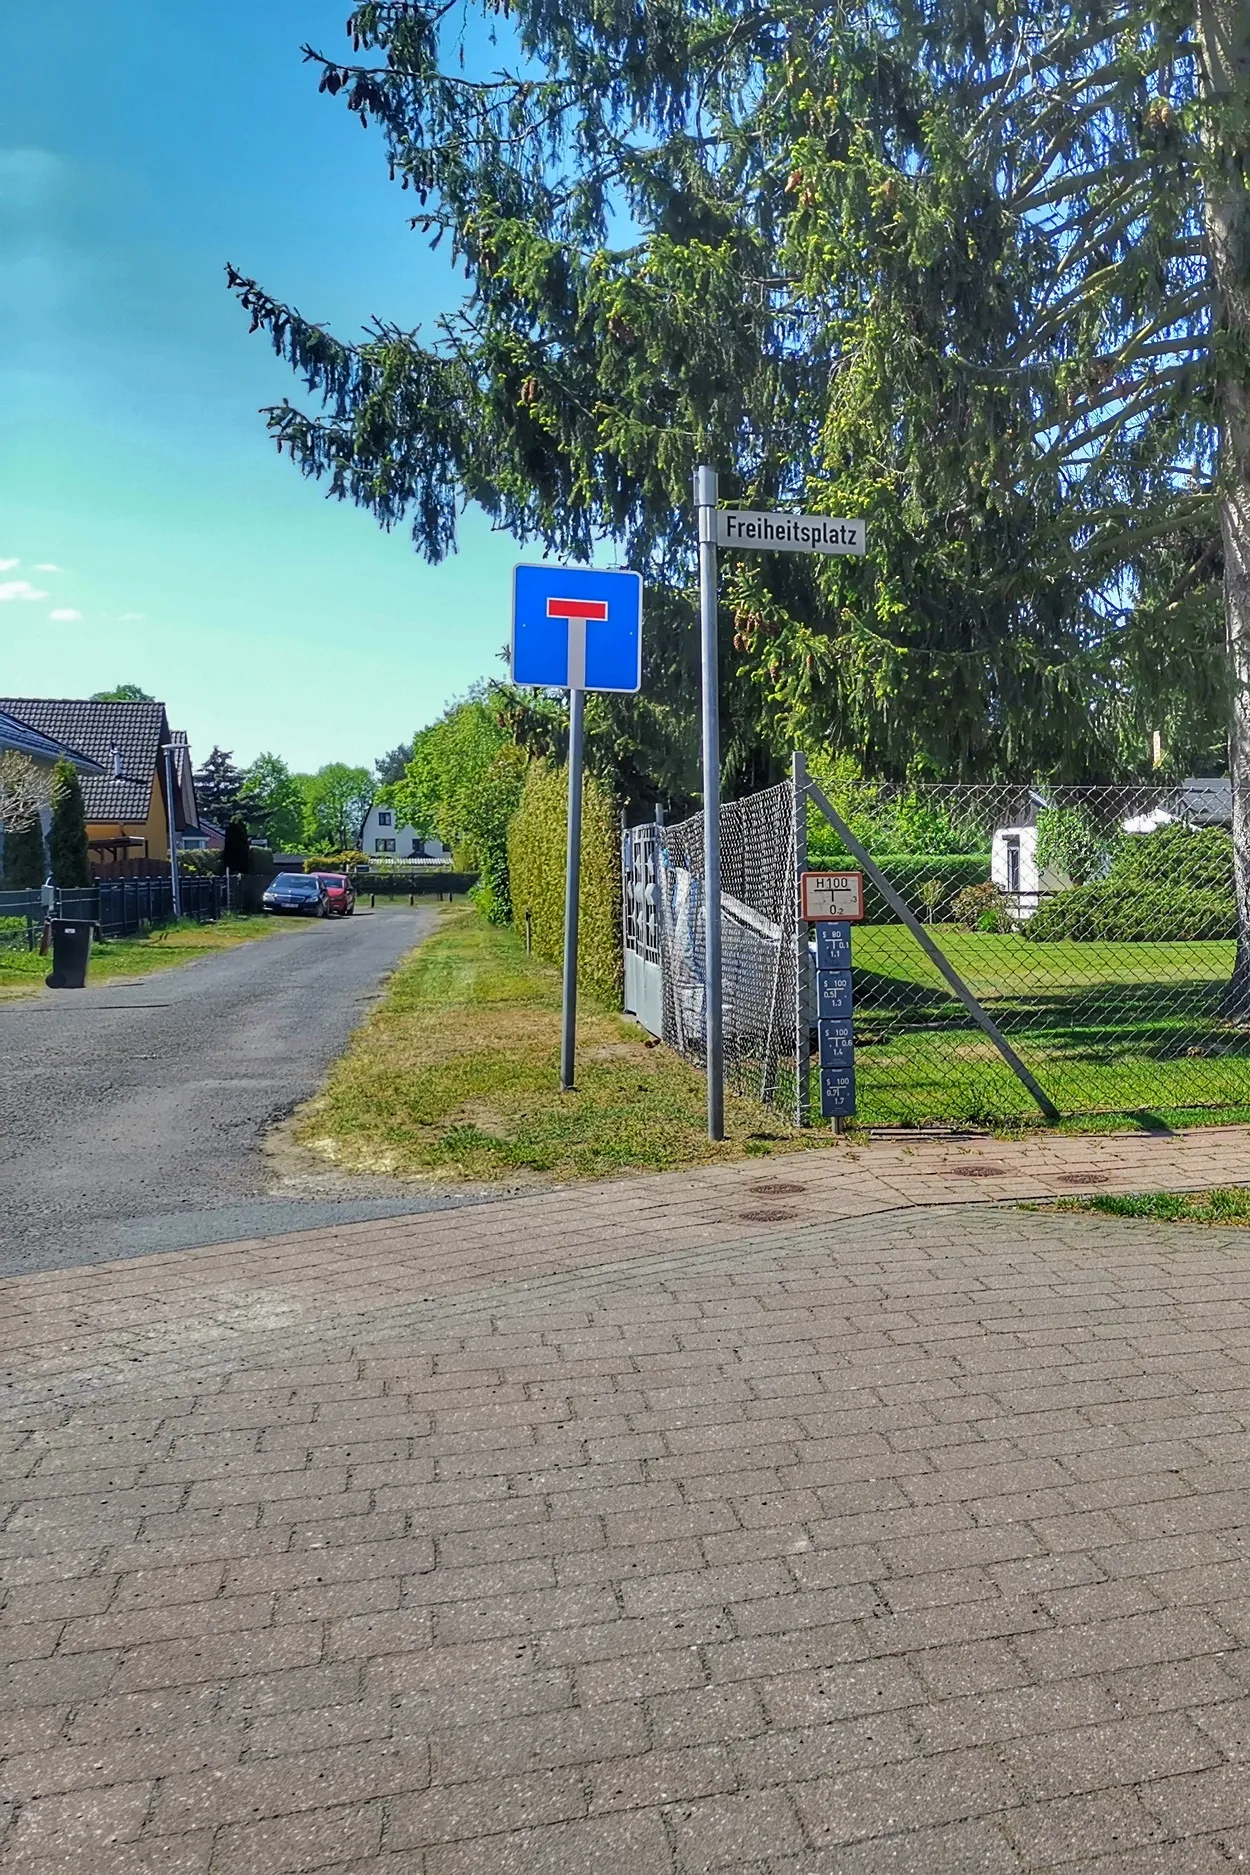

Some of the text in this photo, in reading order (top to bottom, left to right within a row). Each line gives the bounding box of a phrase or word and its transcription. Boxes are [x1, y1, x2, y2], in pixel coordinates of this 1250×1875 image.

[726, 516, 857, 548] Freiheitsplatz
[822, 930, 842, 939] S 80
[838, 941, 849, 949] 0.1
[830, 950, 840, 958] 1.1
[823, 979, 847, 988] S 100
[832, 999, 842, 1007] 1.3
[825, 1028, 849, 1037] S 100
[826, 1077, 850, 1086] S 100
[835, 1097, 845, 1105] 1.7
